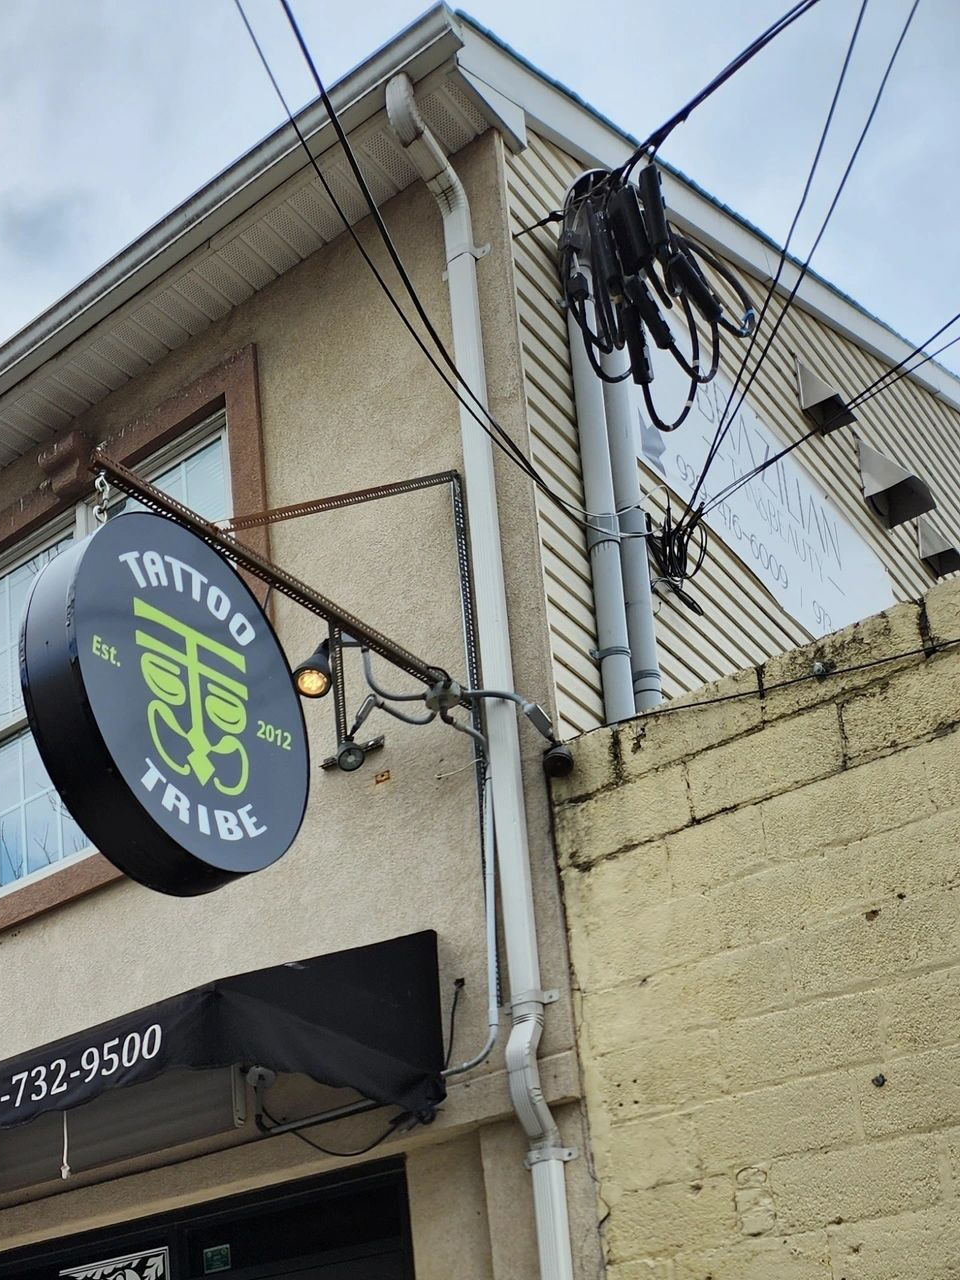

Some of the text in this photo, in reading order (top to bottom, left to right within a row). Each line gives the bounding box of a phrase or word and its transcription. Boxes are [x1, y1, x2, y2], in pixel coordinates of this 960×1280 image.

[118, 550, 256, 647] TATTOO
[92, 633, 122, 668] Est.
[256, 720, 292, 751] 2012
[140, 757, 267, 841] TRIBE
